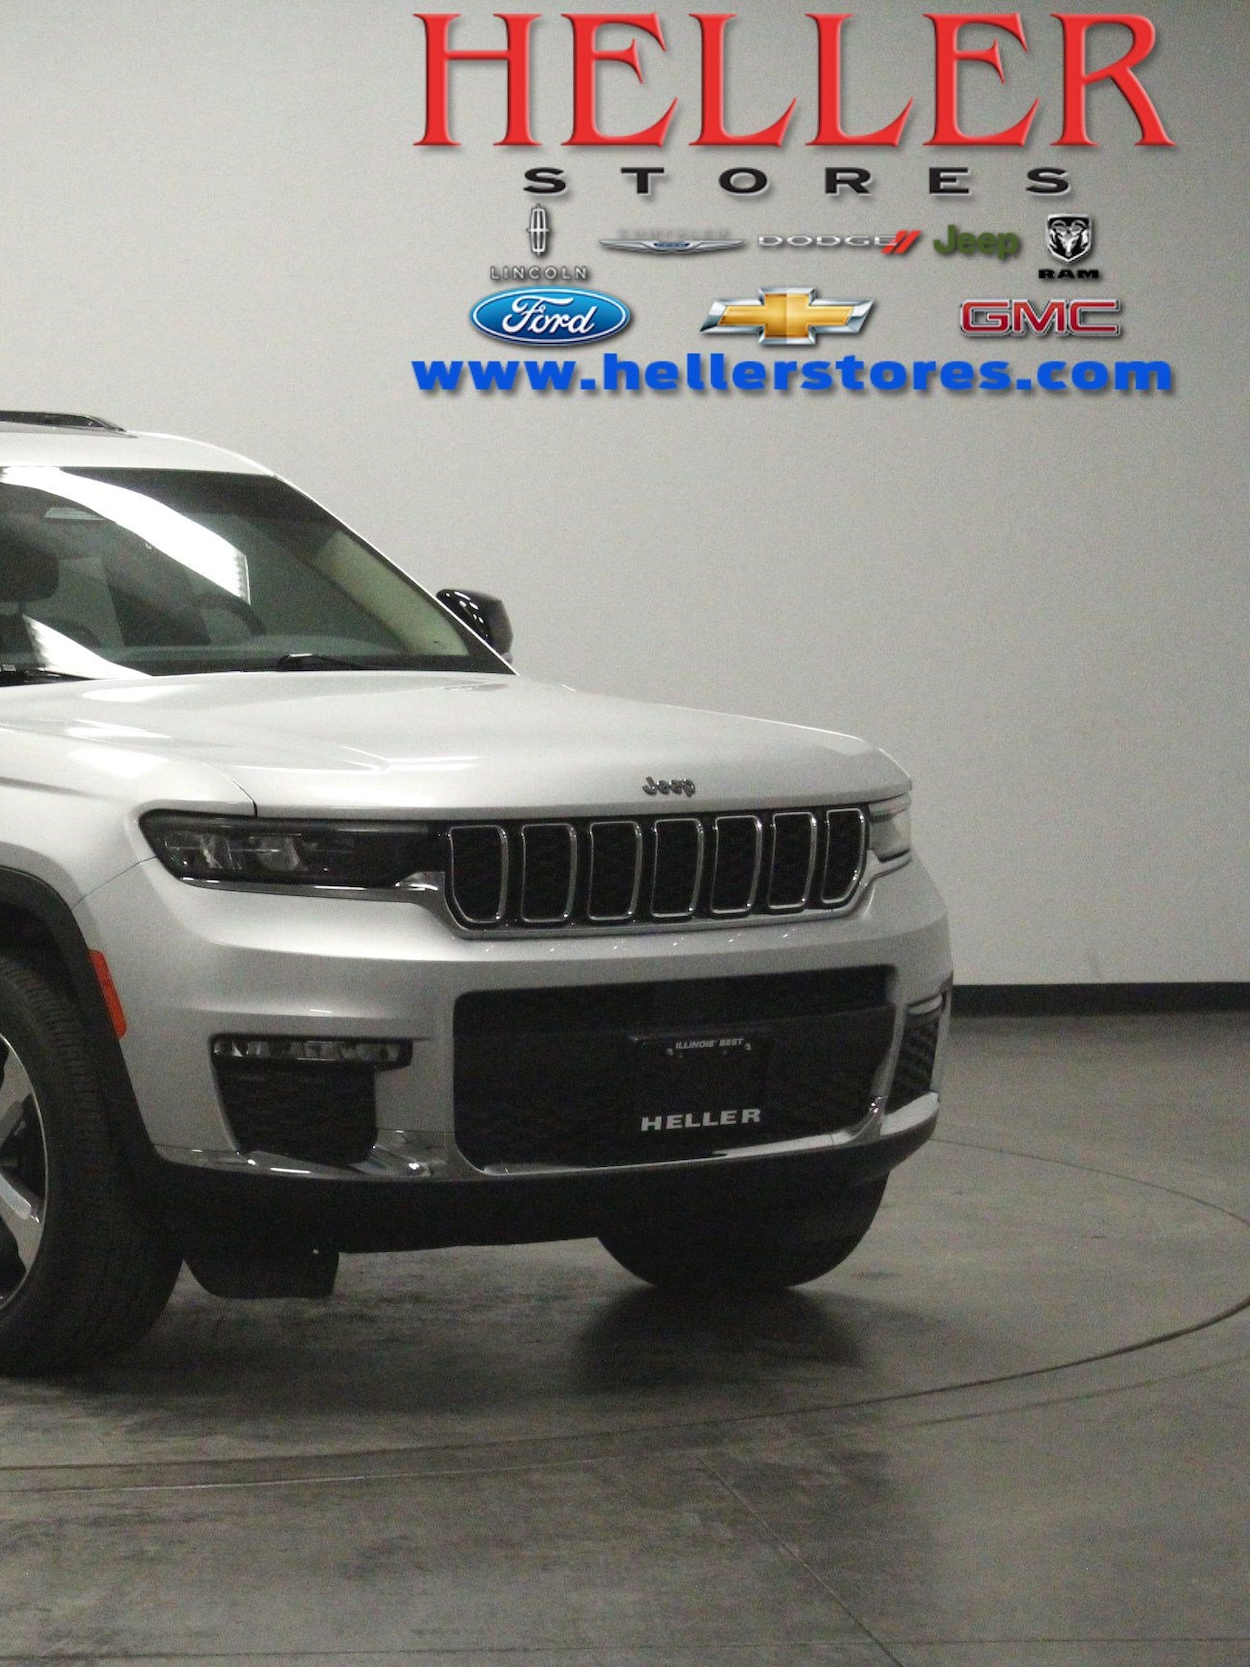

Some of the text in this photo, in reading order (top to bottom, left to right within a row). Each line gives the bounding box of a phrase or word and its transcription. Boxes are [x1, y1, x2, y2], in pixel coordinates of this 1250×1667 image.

[642, 776, 696, 798] Jeep
[719, 1038, 744, 1047] BEST
[640, 1108, 762, 1132] HELLER
